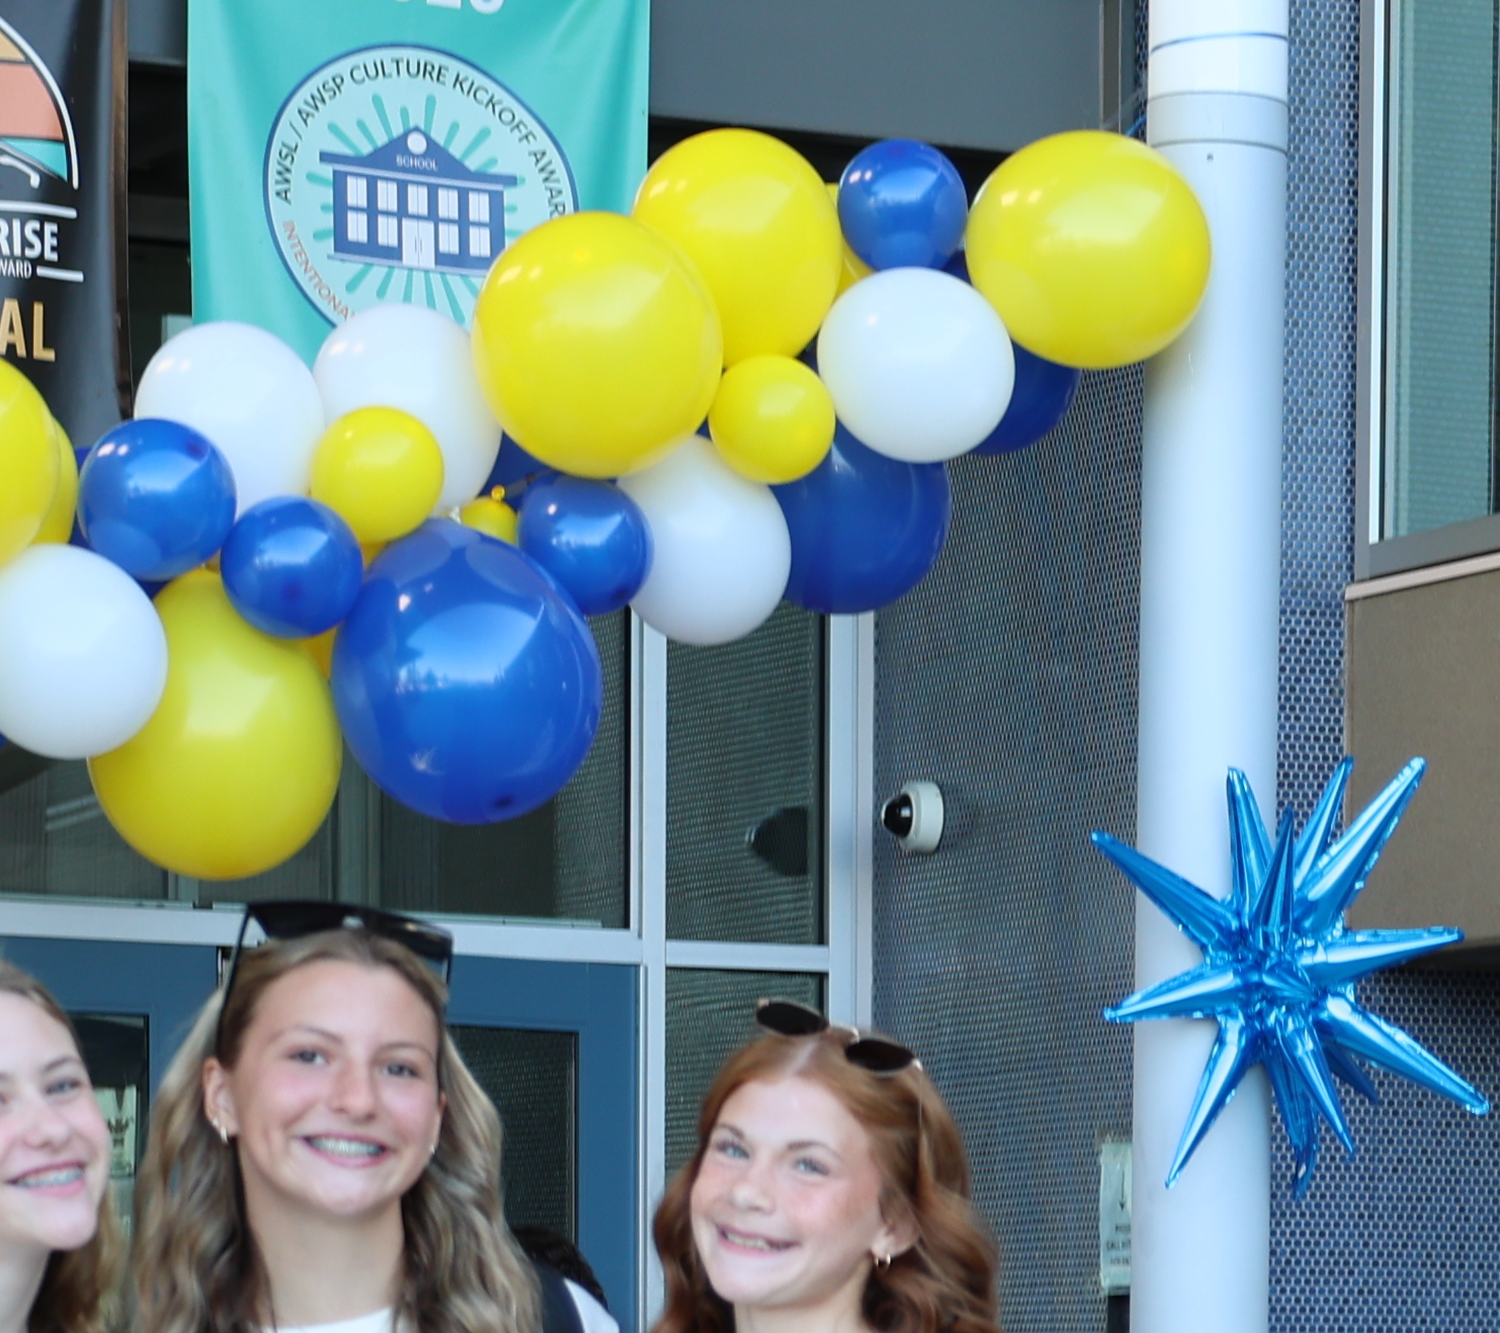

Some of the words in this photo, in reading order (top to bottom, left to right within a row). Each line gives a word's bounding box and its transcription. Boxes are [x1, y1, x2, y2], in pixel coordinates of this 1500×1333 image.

[274, 140, 299, 206] AWSL
[297, 73, 345, 128] AWSP
[349, 57, 449, 86] CULTURE
[452, 71, 538, 146] KICKOFF
[528, 148, 567, 220] AWAR
[396, 153, 439, 172] SCHOOL
[281, 219, 355, 322] INTENTIONA
